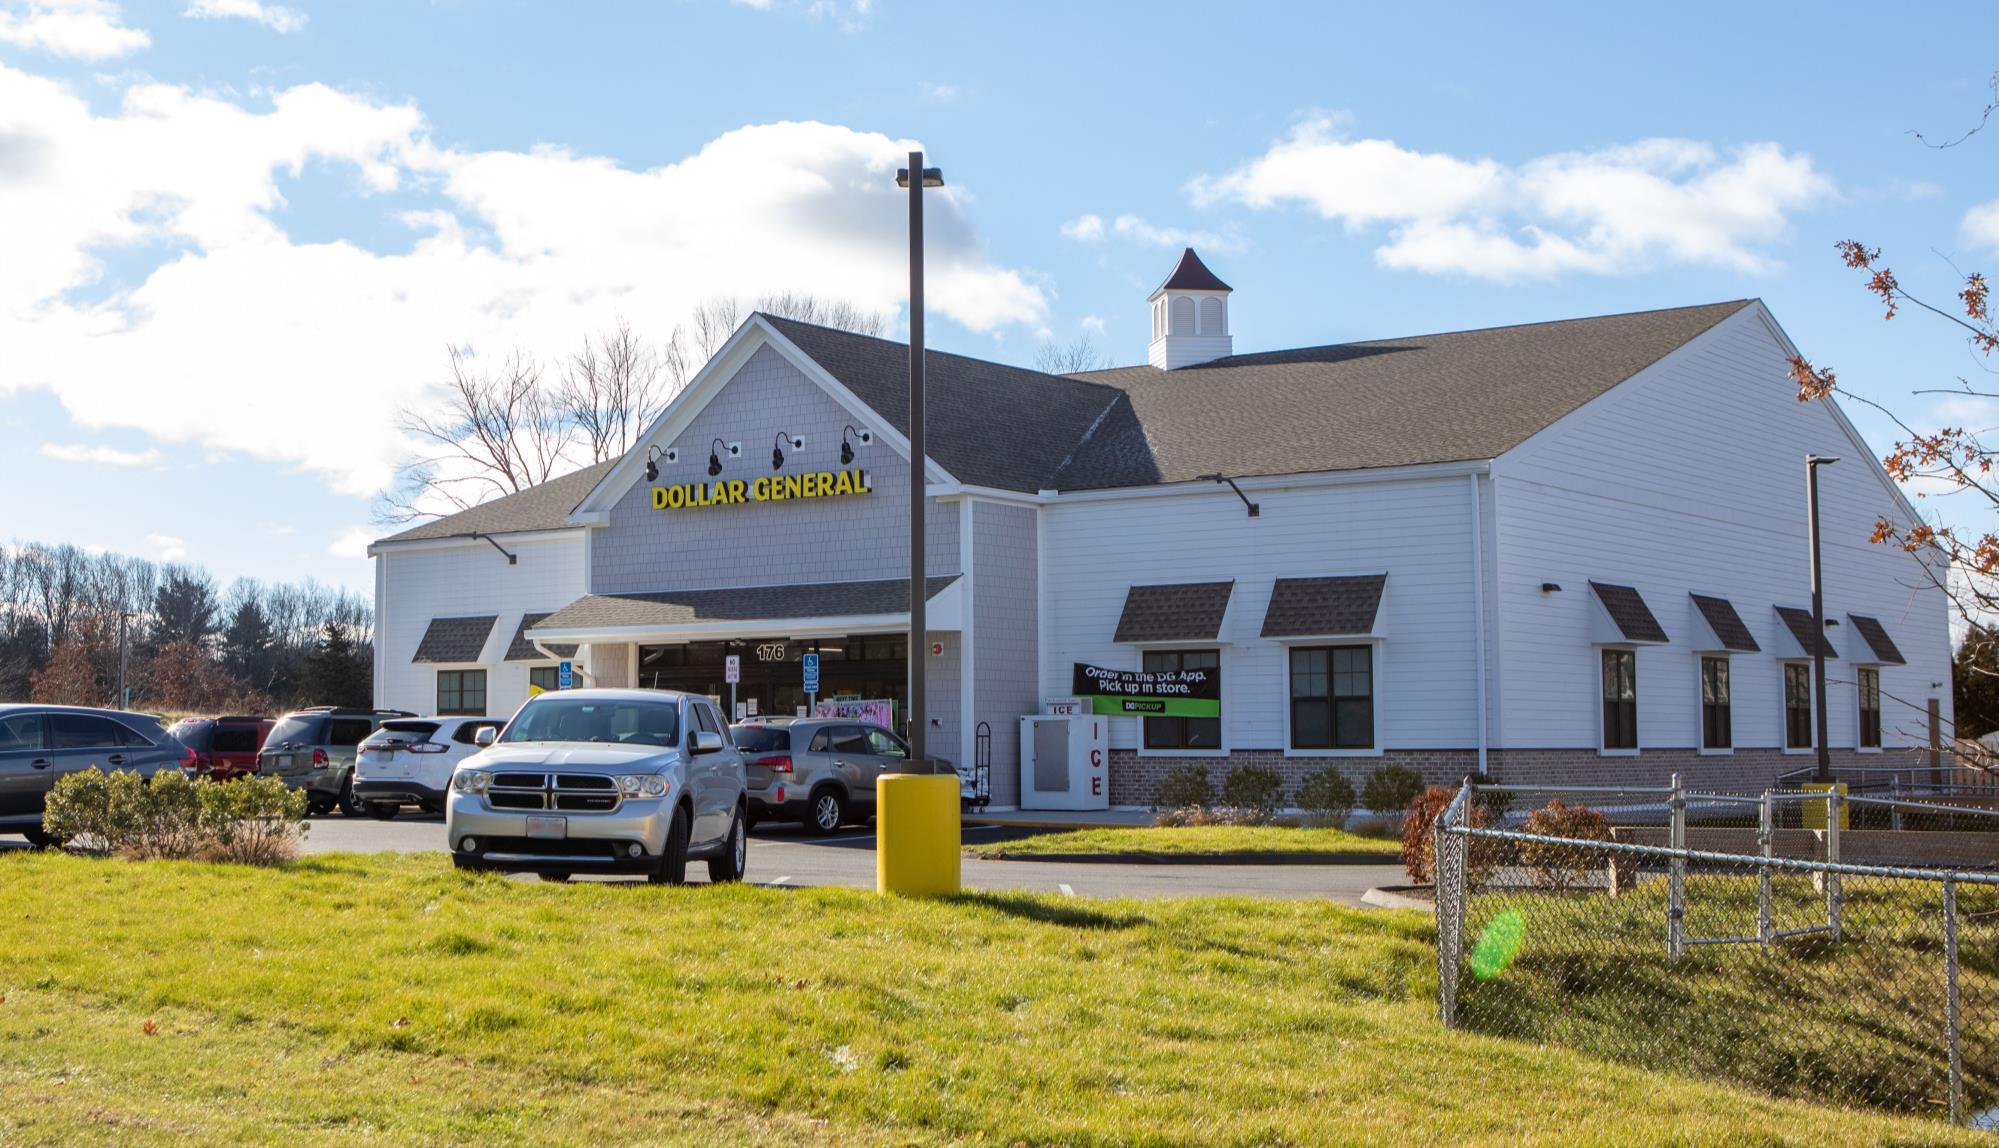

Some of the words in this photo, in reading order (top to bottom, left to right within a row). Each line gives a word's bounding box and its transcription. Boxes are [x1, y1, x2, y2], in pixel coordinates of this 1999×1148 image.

[652, 480, 747, 509] DOLLAR
[753, 469, 870, 501] GENERAL
[757, 644, 784, 660] 176
[1157, 672, 1176, 681] DG
[1179, 671, 1207, 682] App.
[1099, 680, 1121, 692] Pick
[1124, 683, 1139, 694] up
[1142, 682, 1153, 693] in
[1156, 682, 1190, 694] store.
[1053, 706, 1073, 714] ICE
[1091, 722, 1102, 796] ICE
